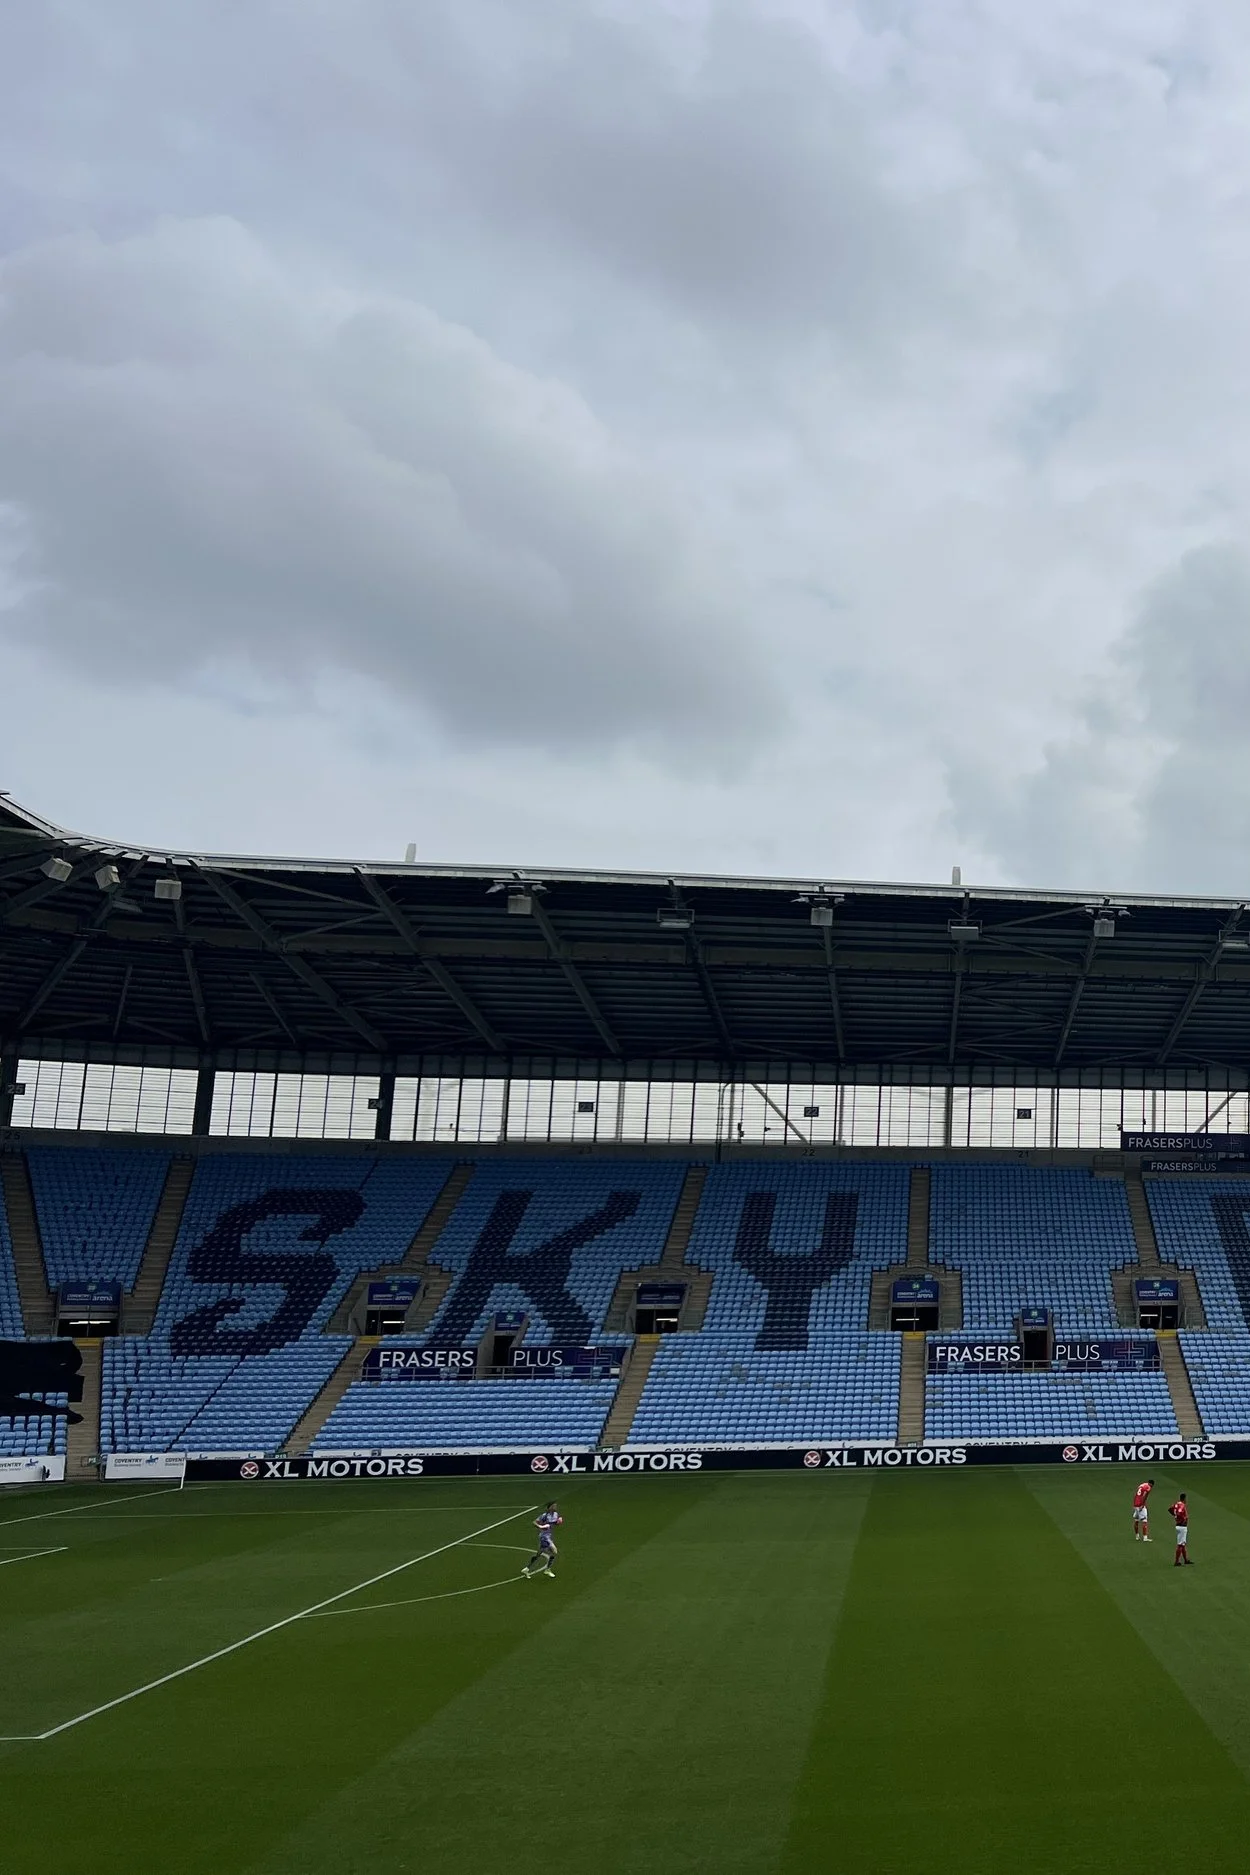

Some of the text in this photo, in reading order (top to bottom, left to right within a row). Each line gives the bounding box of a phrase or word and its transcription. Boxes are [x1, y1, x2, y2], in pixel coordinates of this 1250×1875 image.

[7, 1083, 23, 1094] 25
[369, 1100, 383, 1109] 24
[806, 1107, 818, 1116] 22
[1018, 1109, 1030, 1118] 21
[1128, 1137, 1213, 1149] FRASERSPLUS
[1151, 1162, 1216, 1171] FRASERSPLUS
[171, 1187, 859, 1357] SKY
[380, 1351, 562, 1367] FRASERS PLUS
[937, 1345, 1099, 1362] FRASERS PLUS
[825, 1448, 966, 1466] XL MOTORS
[1082, 1444, 1216, 1461] XL MOTORS
[264, 1458, 423, 1477] XL MOTORS
[553, 1453, 702, 1472] XL MOTORS
